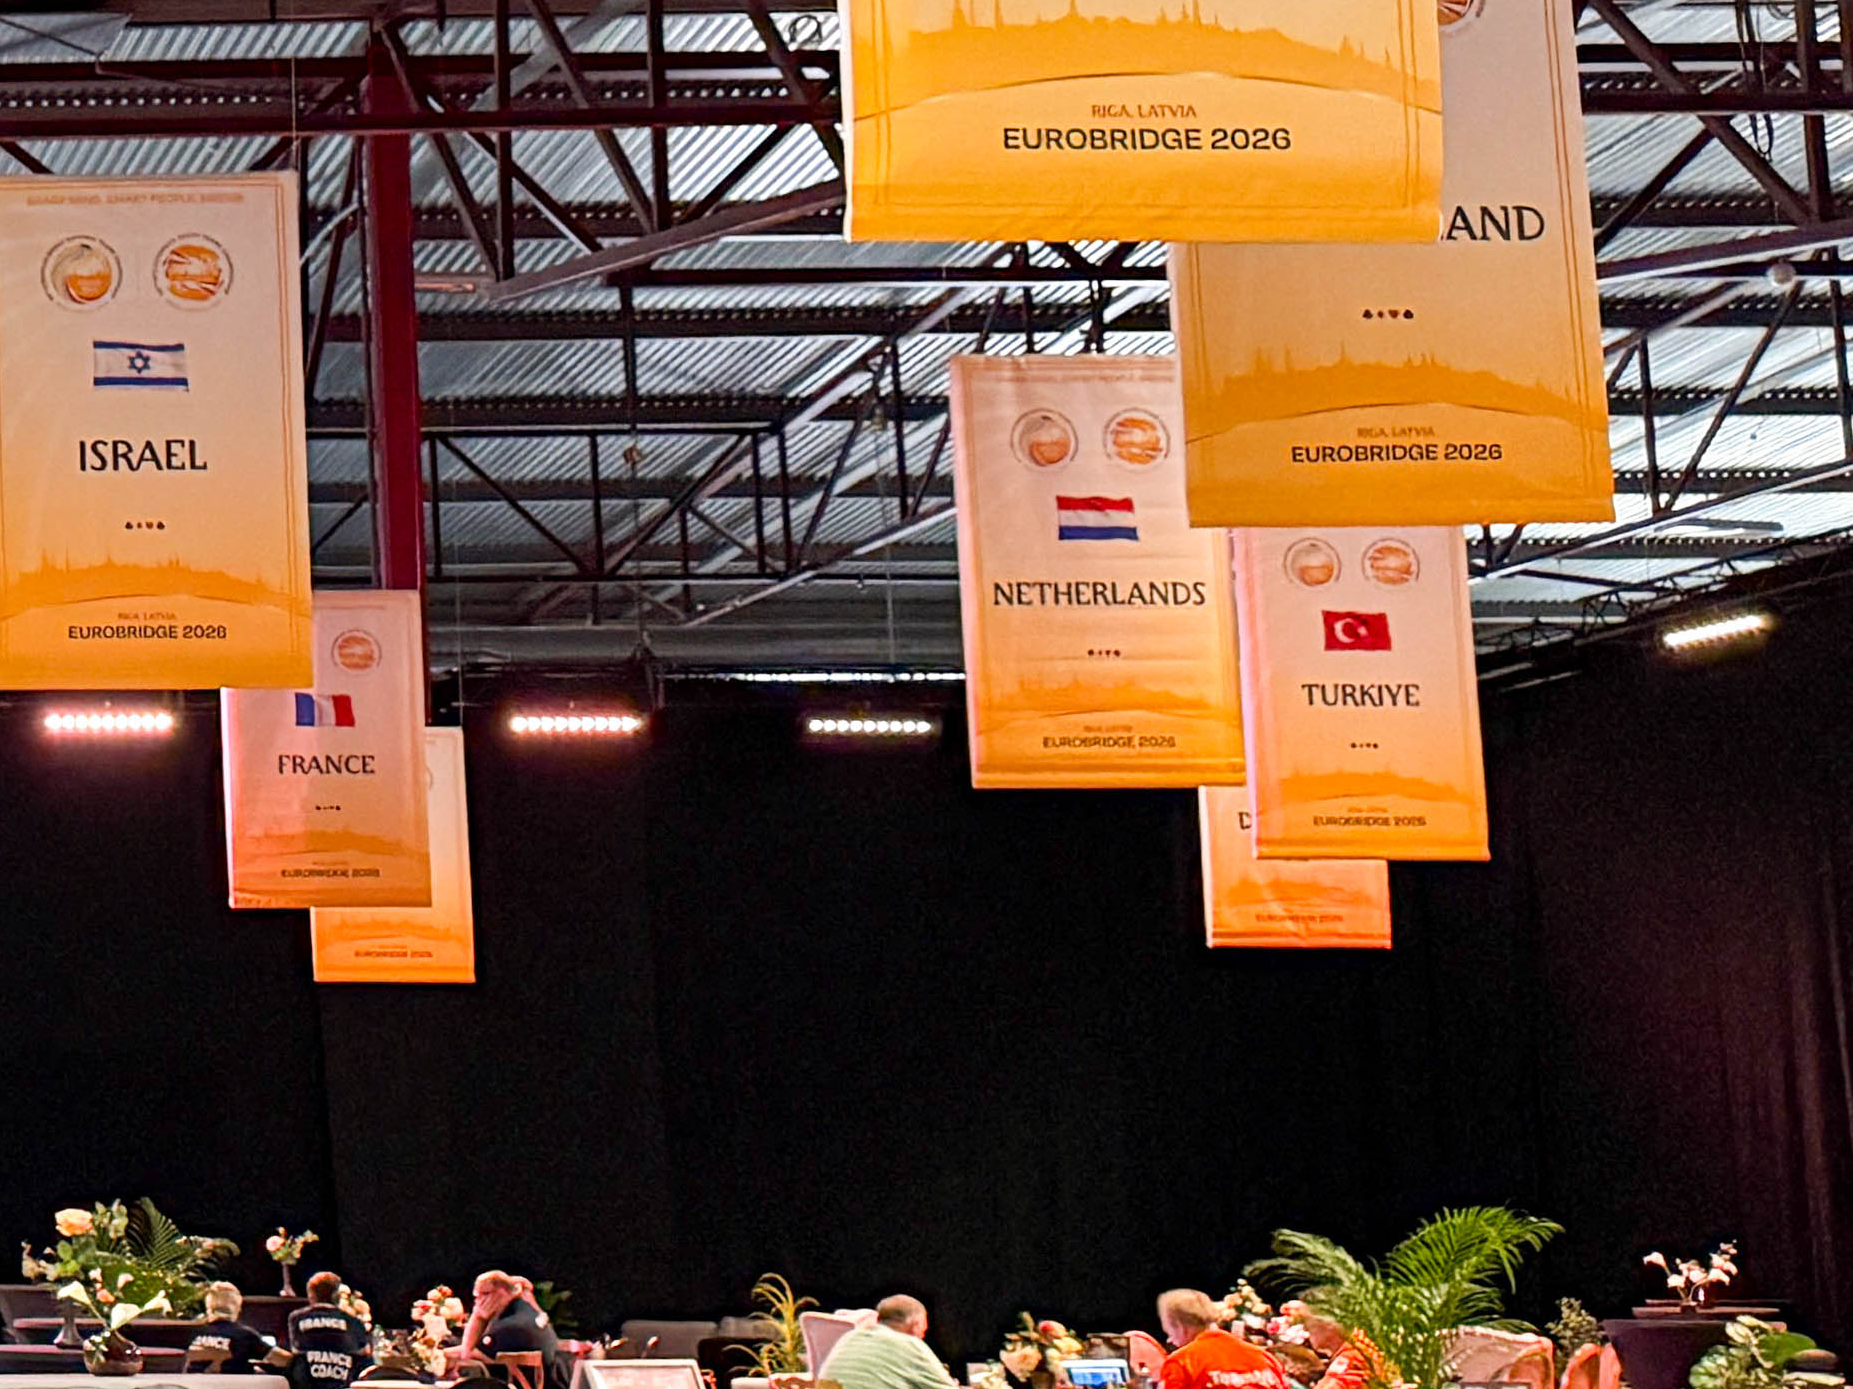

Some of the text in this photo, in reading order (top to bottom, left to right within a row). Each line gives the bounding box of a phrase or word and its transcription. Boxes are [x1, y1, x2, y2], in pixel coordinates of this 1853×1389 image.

[1138, 104, 1197, 119] LATVIA
[1003, 127, 1292, 151] EUROBRIDGE 2026
[78, 439, 208, 472] ISRAEL
[1291, 443, 1503, 463] EUROBRIDGE 2026
[993, 581, 1207, 606] NETHERLANDS
[67, 624, 228, 640] EUROBRIDGE 2026
[1301, 683, 1422, 707] TURKIYE
[278, 755, 376, 775] FRANCE
[298, 1317, 347, 1331] FRANCE
[307, 1350, 352, 1368] FRANCE
[310, 1363, 348, 1380] COACH
